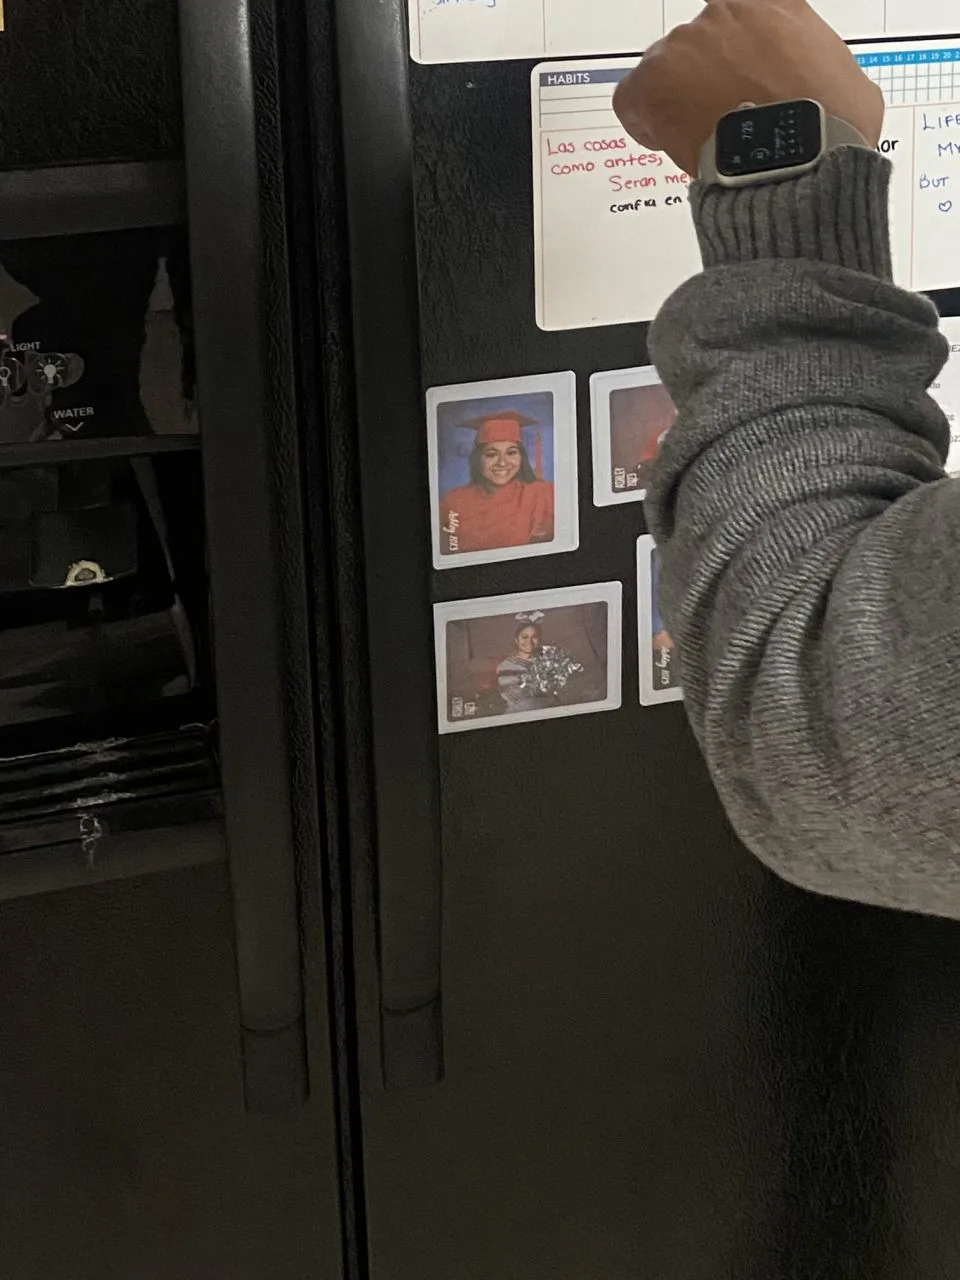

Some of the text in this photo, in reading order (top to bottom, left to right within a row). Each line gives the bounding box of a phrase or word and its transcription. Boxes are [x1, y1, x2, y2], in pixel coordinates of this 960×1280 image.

[548, 72, 590, 85] HABITS
[547, 137, 626, 156] Las cosas
[552, 161, 595, 175] como
[609, 175, 656, 192] Seran
[920, 173, 949, 189] BUT
[610, 196, 682, 214] confia en
[11, 342, 41, 351] LIGHT
[54, 407, 94, 418] WATER
